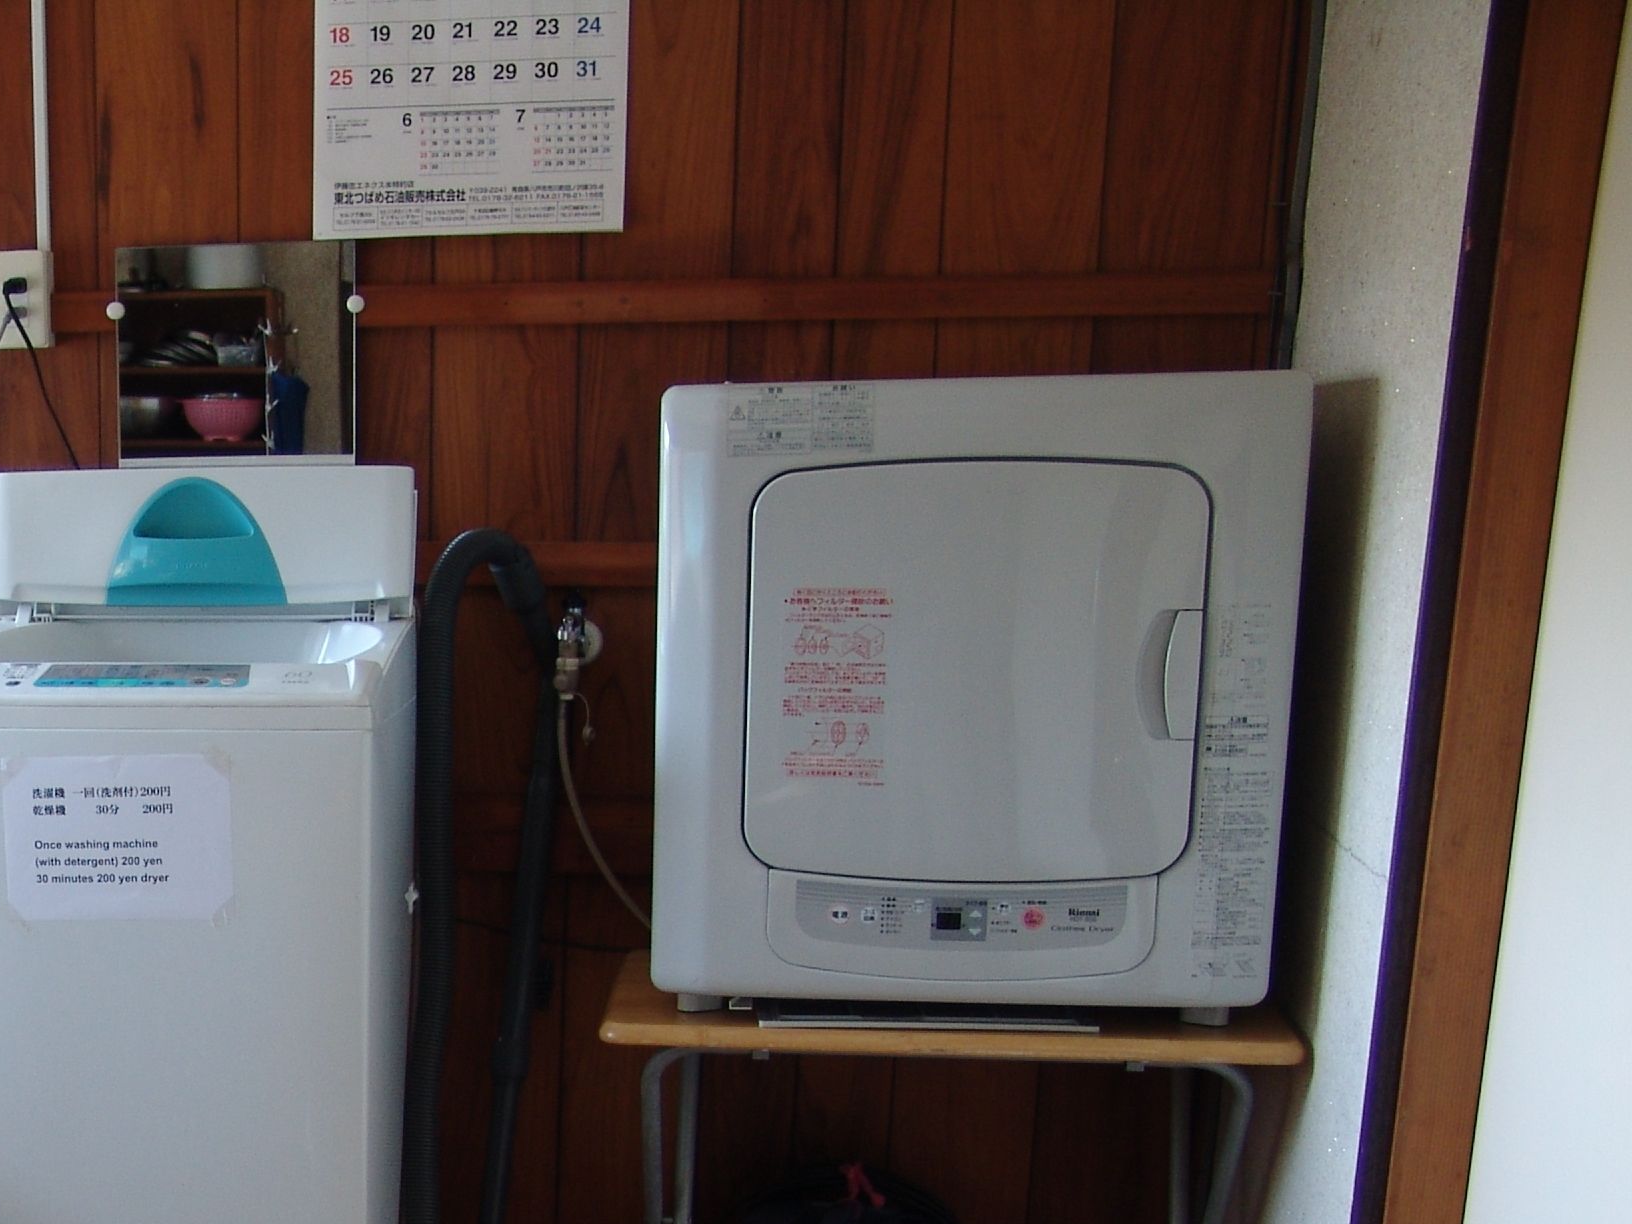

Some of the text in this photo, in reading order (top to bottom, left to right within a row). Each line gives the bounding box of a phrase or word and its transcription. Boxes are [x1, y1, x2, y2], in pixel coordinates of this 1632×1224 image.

[329, 16, 602, 44] 18 19 20 21 22 23 24
[329, 60, 598, 86] 25 26 27 28 29 30 31
[402, 112, 412, 127] 6
[515, 108, 526, 123] 7
[32, 802, 173, 816] 乾燥機 30分 200円
[34, 838, 158, 851] Once washing machine
[35, 856, 163, 869] (with detergent) 200 yen
[36, 873, 170, 886] 30 minutes 200 yen dryer
